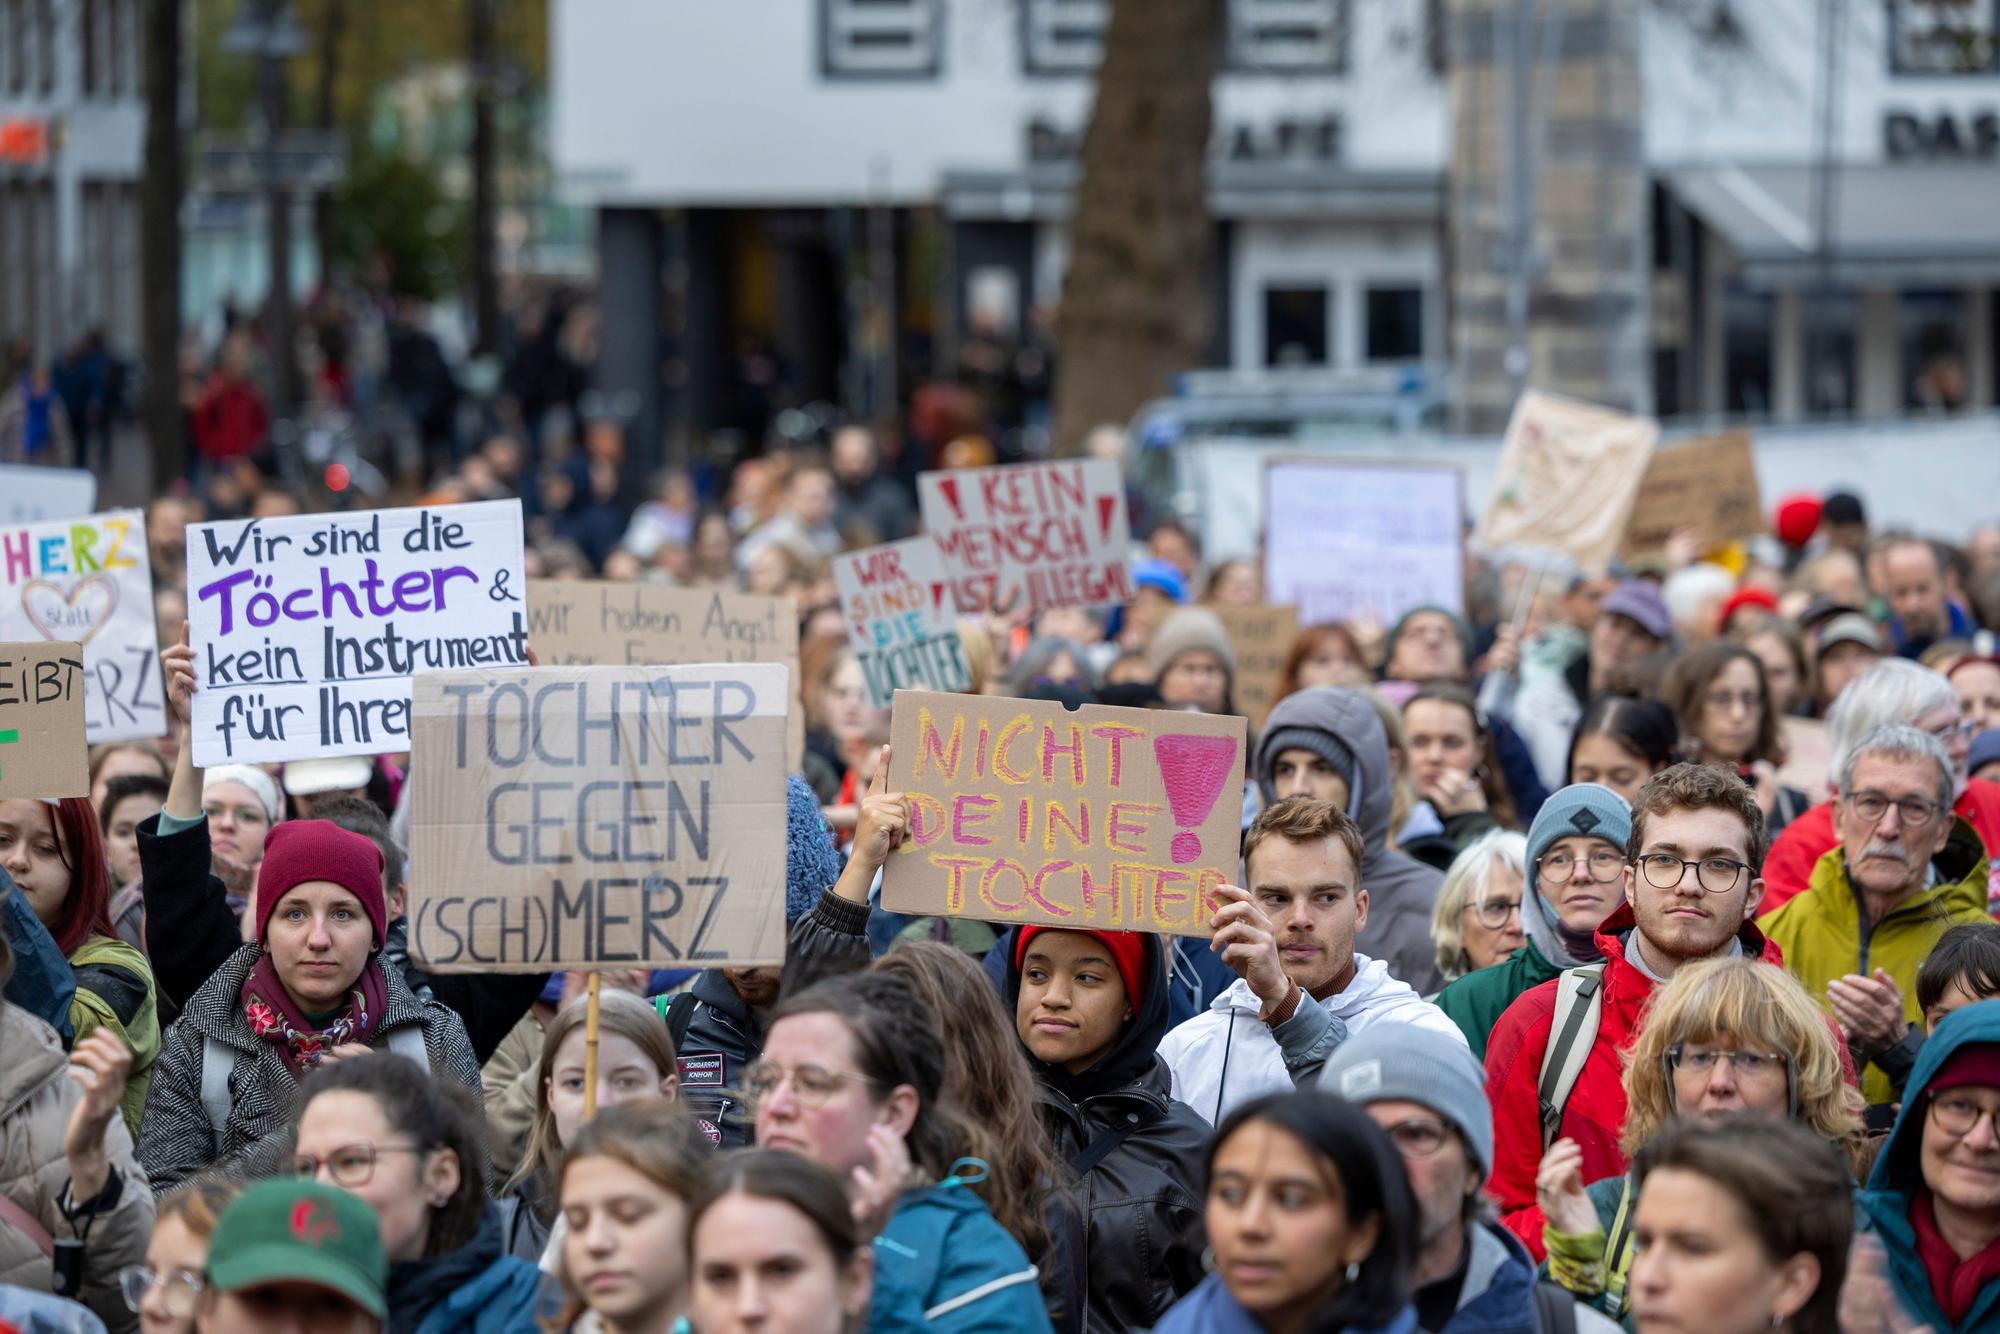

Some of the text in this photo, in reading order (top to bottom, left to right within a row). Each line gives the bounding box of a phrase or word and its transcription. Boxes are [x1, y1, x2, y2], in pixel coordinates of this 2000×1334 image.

[979, 464, 1086, 519] KEIN
[2, 520, 137, 586] HERZ
[202, 510, 474, 567] Wir sind die
[852, 549, 908, 588] WIR
[934, 514, 1090, 570] MENSCH
[199, 558, 521, 637] Töchter &
[601, 587, 683, 634] haben
[701, 592, 778, 663] Angst
[850, 580, 928, 623] SIND
[951, 572, 1000, 615] IST
[207, 637, 304, 685] kein
[324, 611, 528, 680] Instrument
[872, 612, 929, 648] DIE
[84, 646, 161, 728] RZ
[215, 693, 304, 757] für
[443, 675, 757, 769] TÖCHTER
[912, 706, 1147, 788] NICHT
[485, 779, 710, 866] GEGEN
[902, 791, 1166, 854] DEINE
[414, 876, 730, 965] (SCH)MERZ
[928, 852, 1230, 929] TOCHTER
